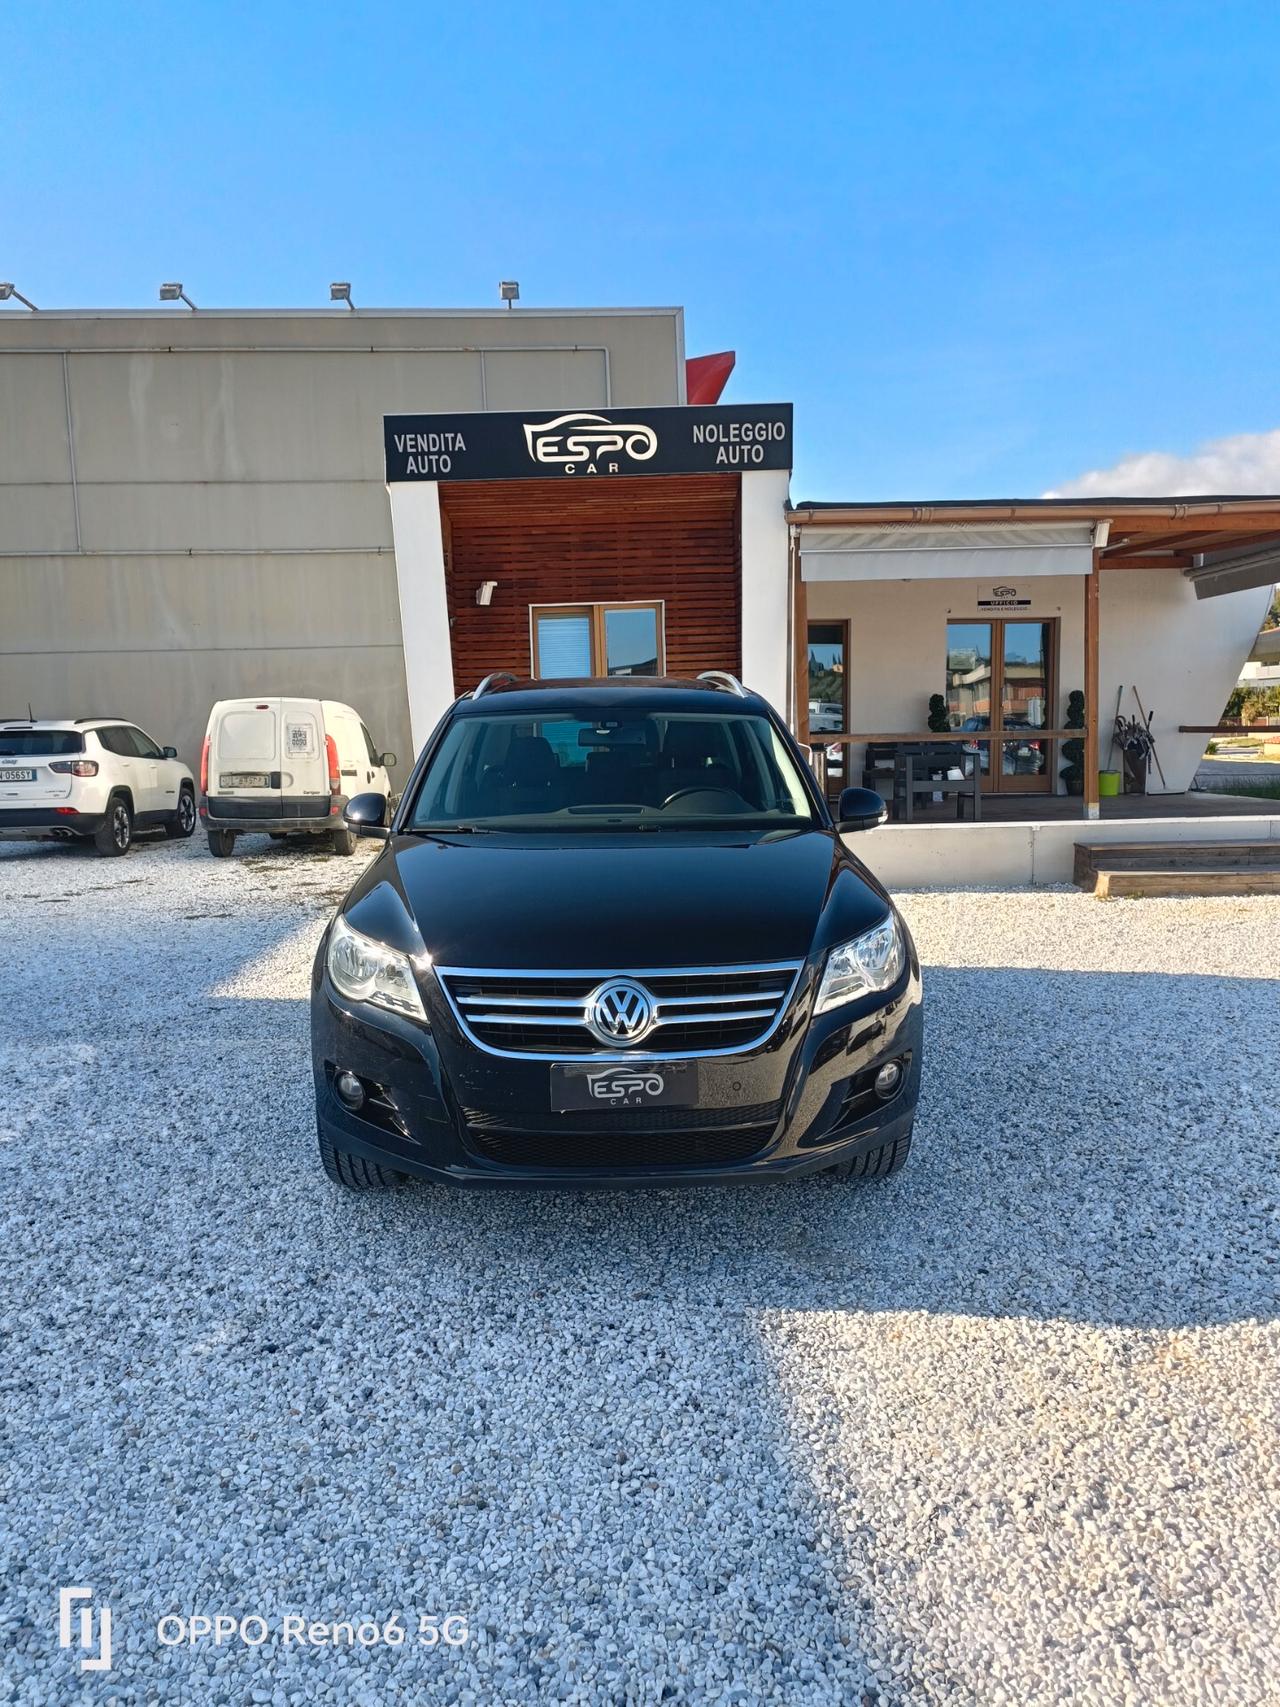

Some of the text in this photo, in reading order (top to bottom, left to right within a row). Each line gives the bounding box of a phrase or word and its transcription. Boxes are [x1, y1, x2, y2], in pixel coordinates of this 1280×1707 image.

[693, 421, 786, 443] NOLEGGIO
[393, 433, 467, 453] VENDITA
[535, 424, 658, 463] ESPO
[406, 454, 451, 474] AUTO
[716, 444, 764, 464] AUTO
[565, 463, 619, 474] CAR
[993, 588, 1017, 597] ESPO
[592, 1073, 664, 1098] ESPO
[610, 1097, 642, 1105] CAR
